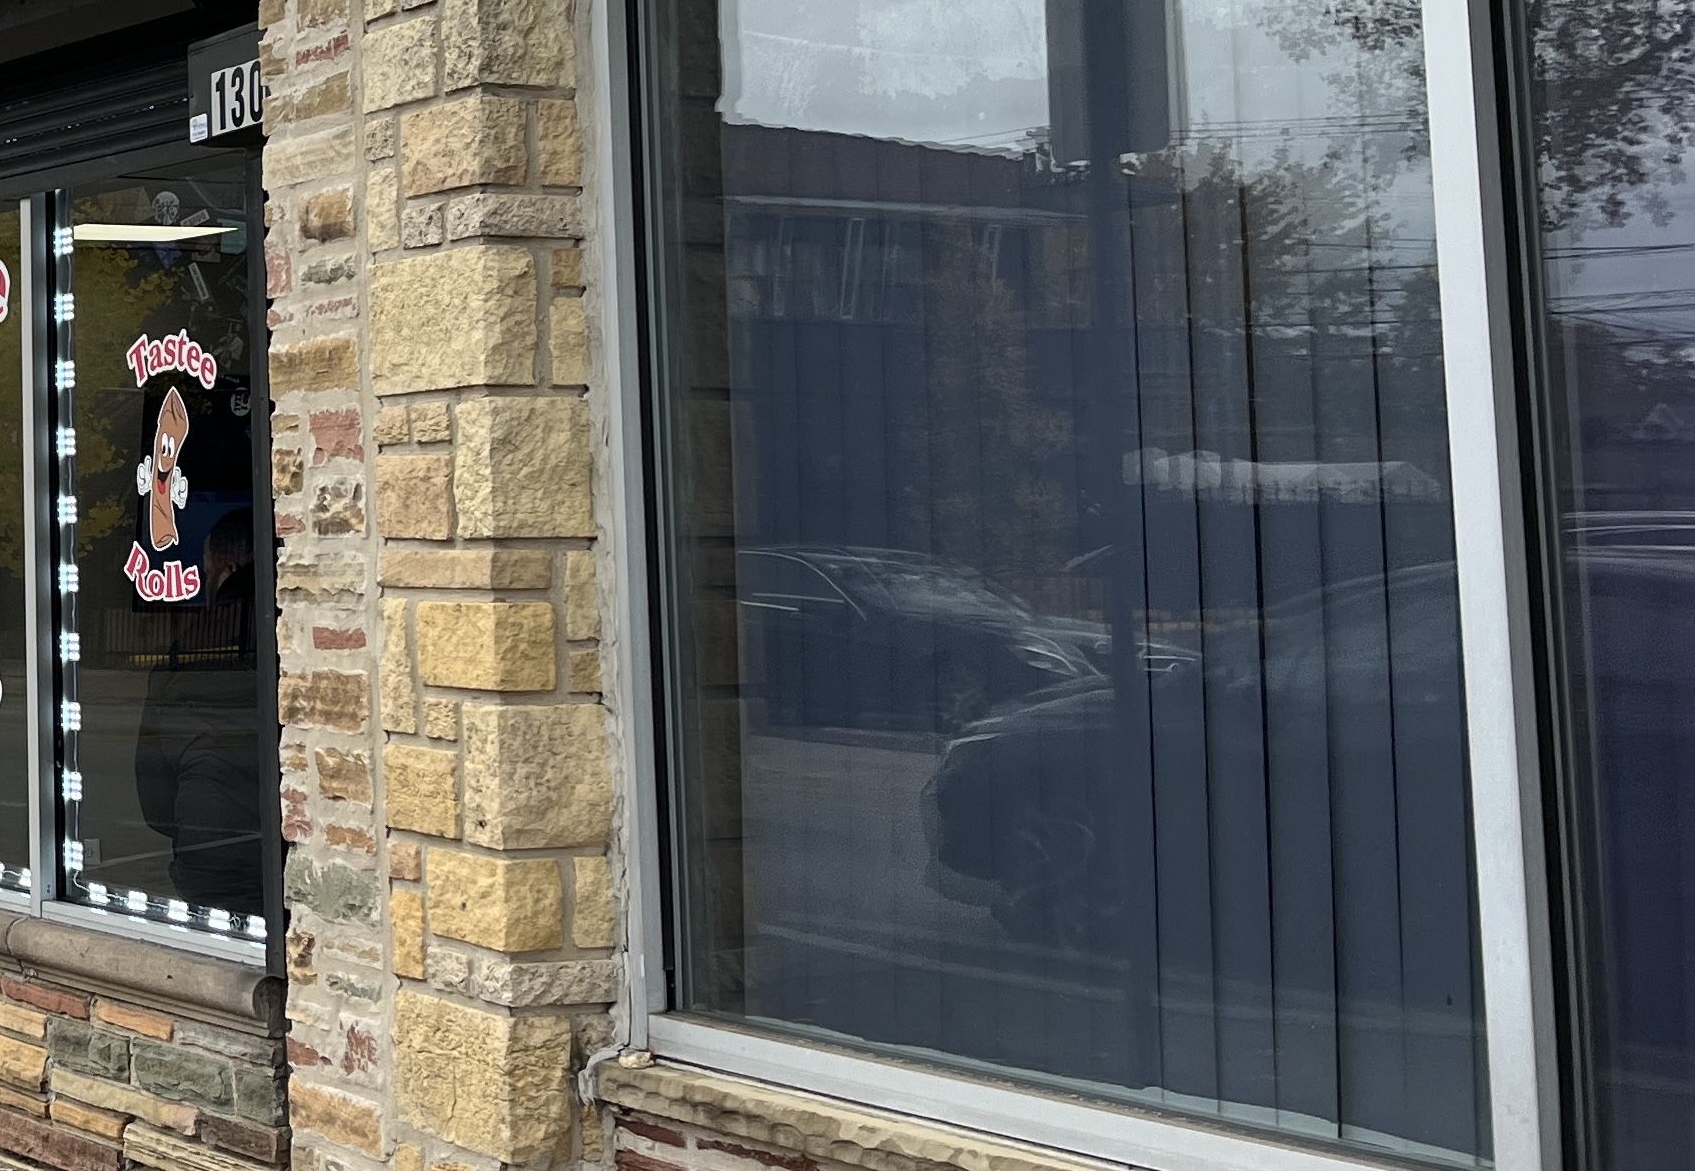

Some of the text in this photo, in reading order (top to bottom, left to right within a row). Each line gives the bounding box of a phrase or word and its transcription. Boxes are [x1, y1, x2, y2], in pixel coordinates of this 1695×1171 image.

[215, 60, 272, 131] 130
[128, 331, 215, 386] Tastee
[125, 543, 199, 599] Rolls
